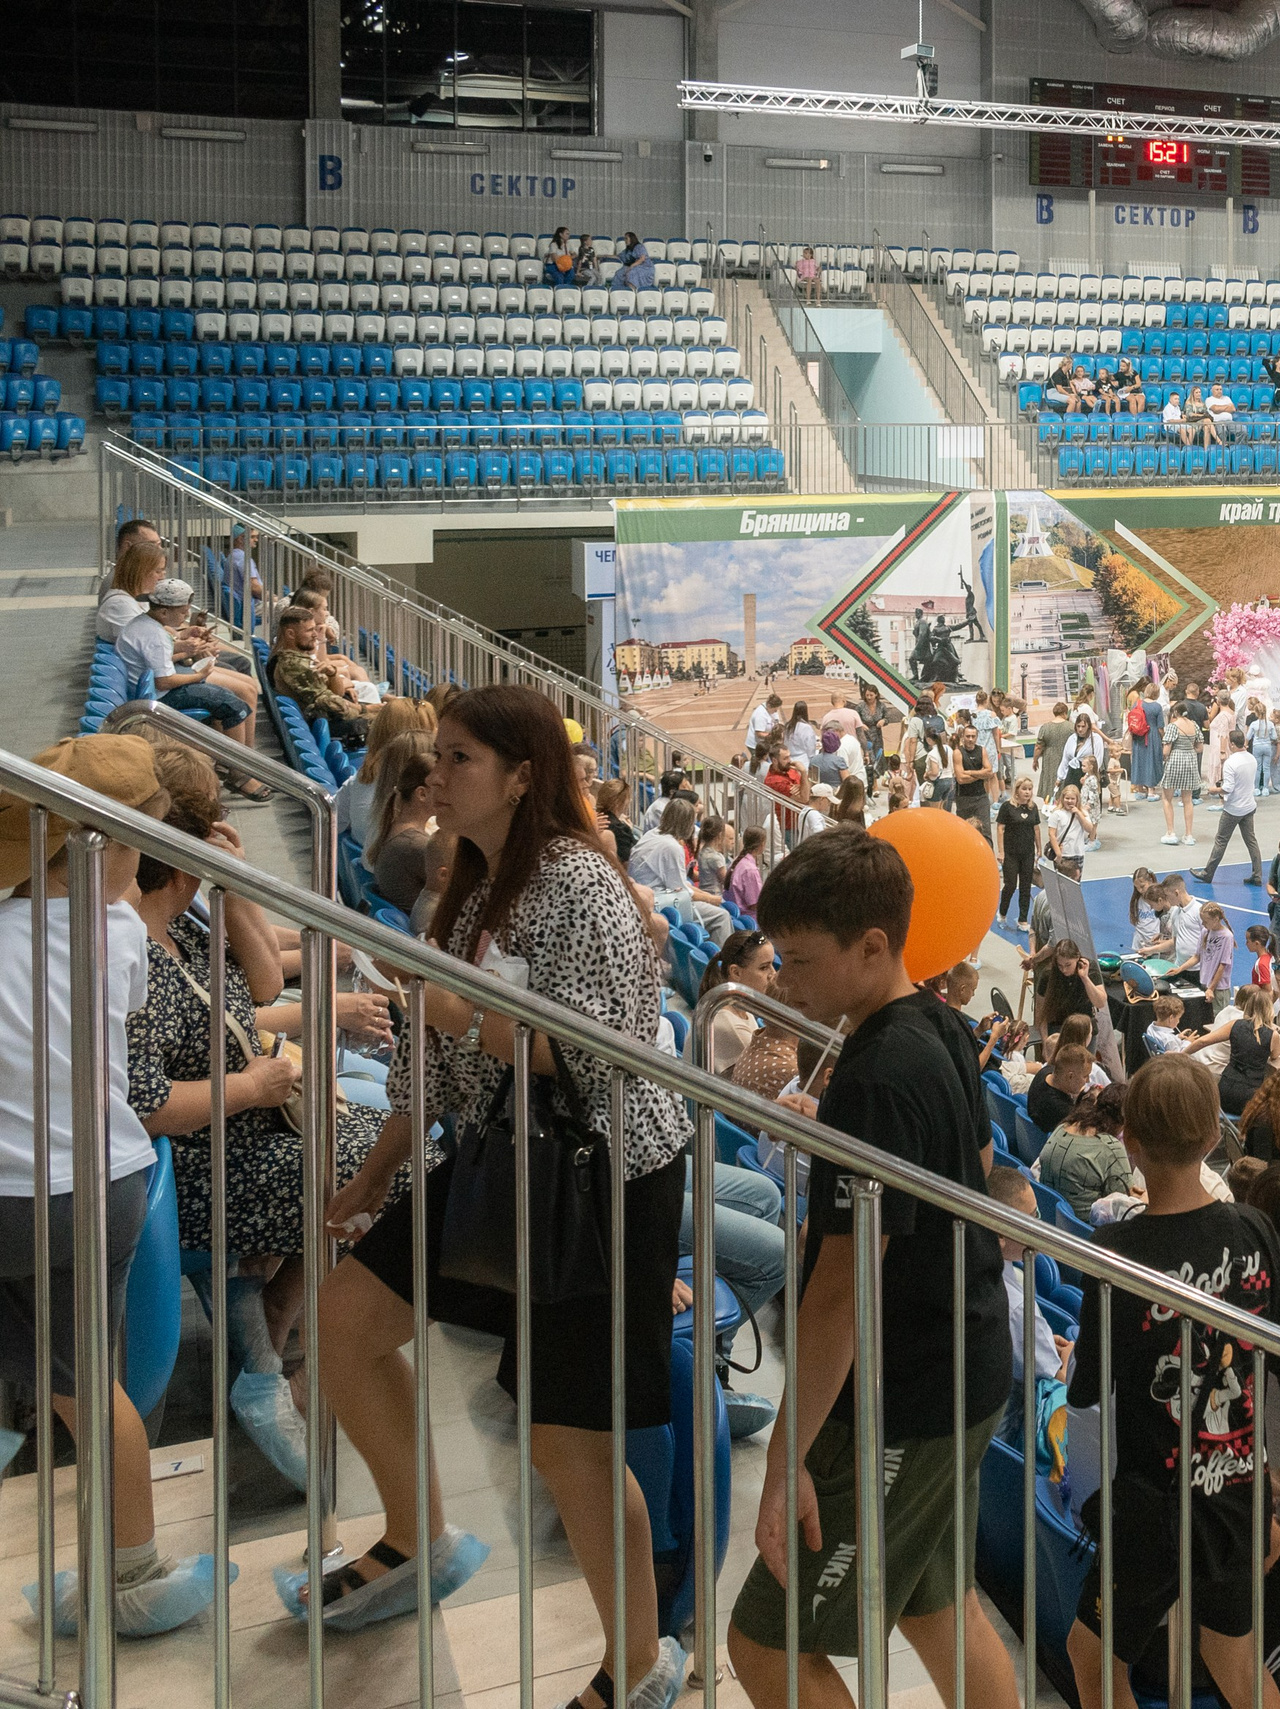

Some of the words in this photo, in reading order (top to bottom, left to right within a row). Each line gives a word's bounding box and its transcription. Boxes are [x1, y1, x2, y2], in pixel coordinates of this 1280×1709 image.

[1106, 97, 1126, 105] СЧЕТ
[1203, 104, 1222, 113] СЧЕТ
[1148, 141, 1187, 163] 15:21
[470, 173, 576, 199] СЕКТОР
[1114, 204, 1196, 228] СЕКТОР
[1219, 497, 1264, 524] край
[739, 510, 850, 537] Брянщина
[170, 1461, 183, 1472] 7
[816, 1542, 857, 1588] NIKE
